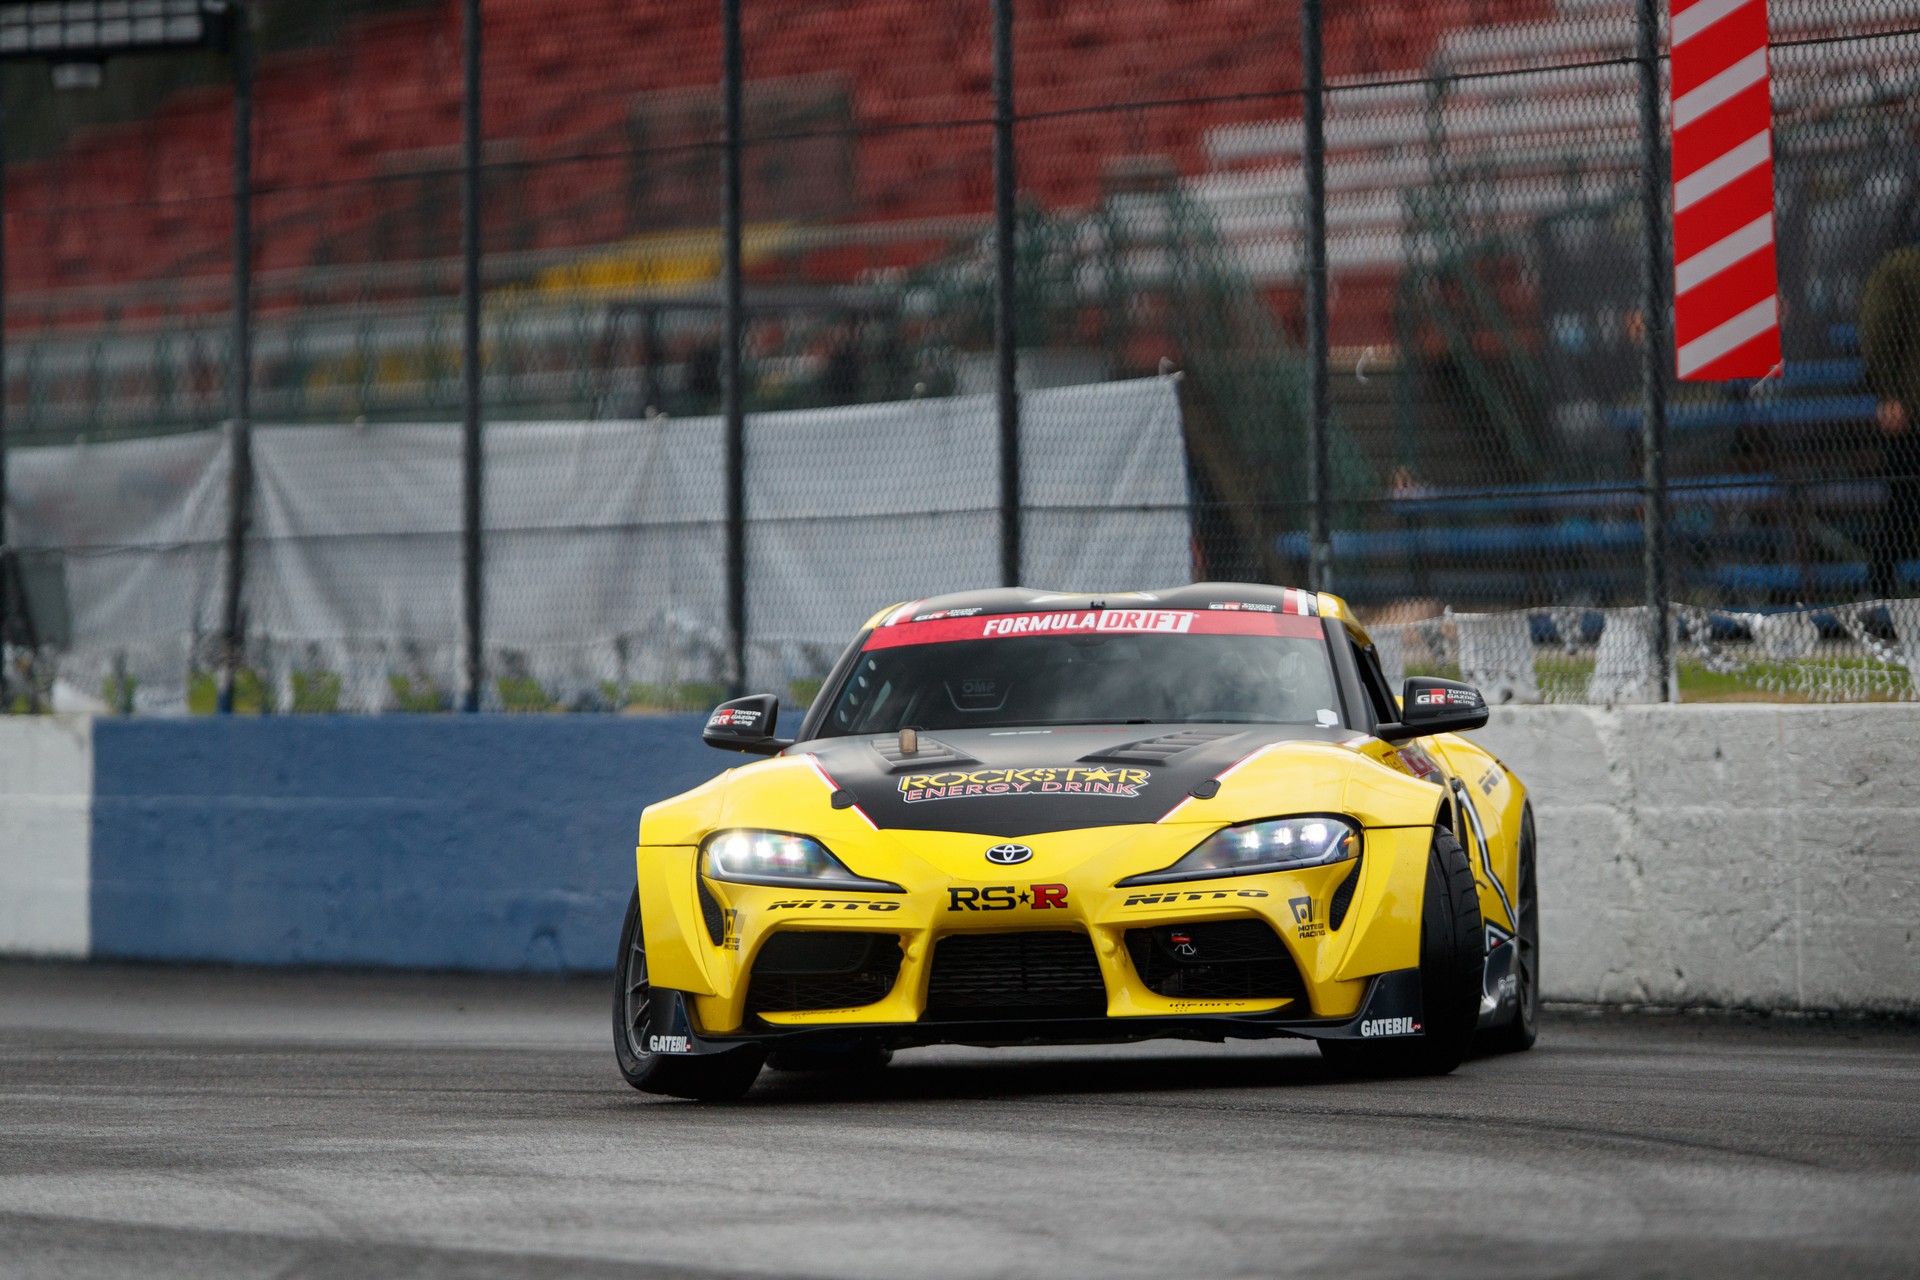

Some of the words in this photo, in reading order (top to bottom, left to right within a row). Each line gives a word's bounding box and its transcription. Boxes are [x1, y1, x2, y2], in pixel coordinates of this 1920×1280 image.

[982, 612, 1096, 636] FORMULA
[1102, 611, 1188, 631] DRIFT
[962, 681, 996, 693] OMP
[1447, 689, 1477, 697] TOYOTA
[1416, 694, 1445, 704] GR
[1446, 693, 1476, 701] GAZOO
[901, 767, 1149, 791] ROCKSTAR
[907, 782, 1032, 801] ENERGY
[1041, 781, 1137, 796] DRINK
[766, 899, 901, 912] NITTO
[1123, 889, 1270, 907] NITTO
[1360, 1016, 1415, 1037] GATEBIL
[649, 1034, 688, 1053] GATEBIL
